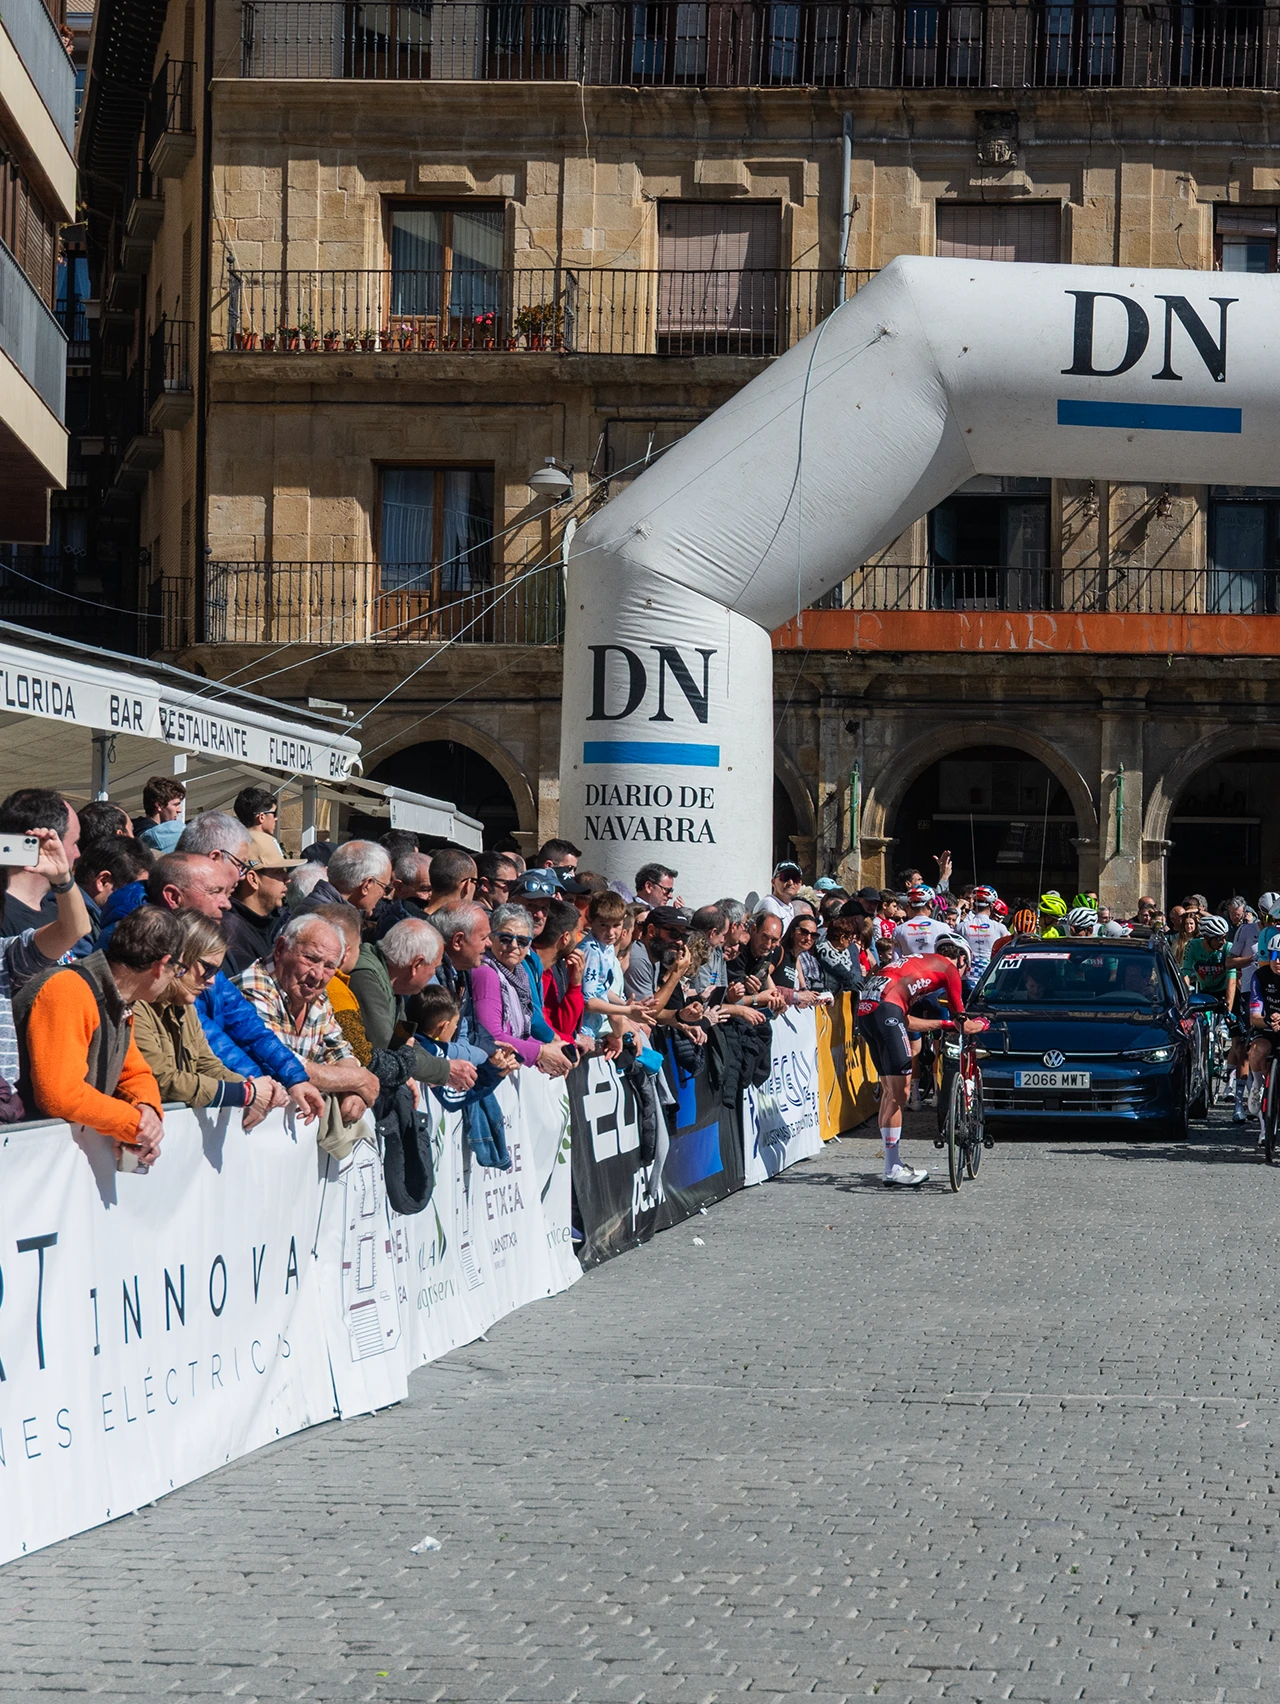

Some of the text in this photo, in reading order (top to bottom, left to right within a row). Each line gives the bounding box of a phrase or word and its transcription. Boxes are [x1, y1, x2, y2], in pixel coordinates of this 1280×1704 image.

[1060, 290, 1239, 383] DN
[586, 644, 718, 724] DN
[110, 694, 144, 732] BAR
[158, 706, 348, 777] RESTAURANTE FLORIDA BAR
[585, 783, 715, 810] DIARIO DE
[584, 815, 717, 844] NAVARRA
[907, 978, 932, 996] Lotto
[1023, 1073, 1087, 1087] 2066 MWT
[89, 1235, 299, 1357] INNOVA
[101, 1333, 292, 1432] ELÉCTRICS
